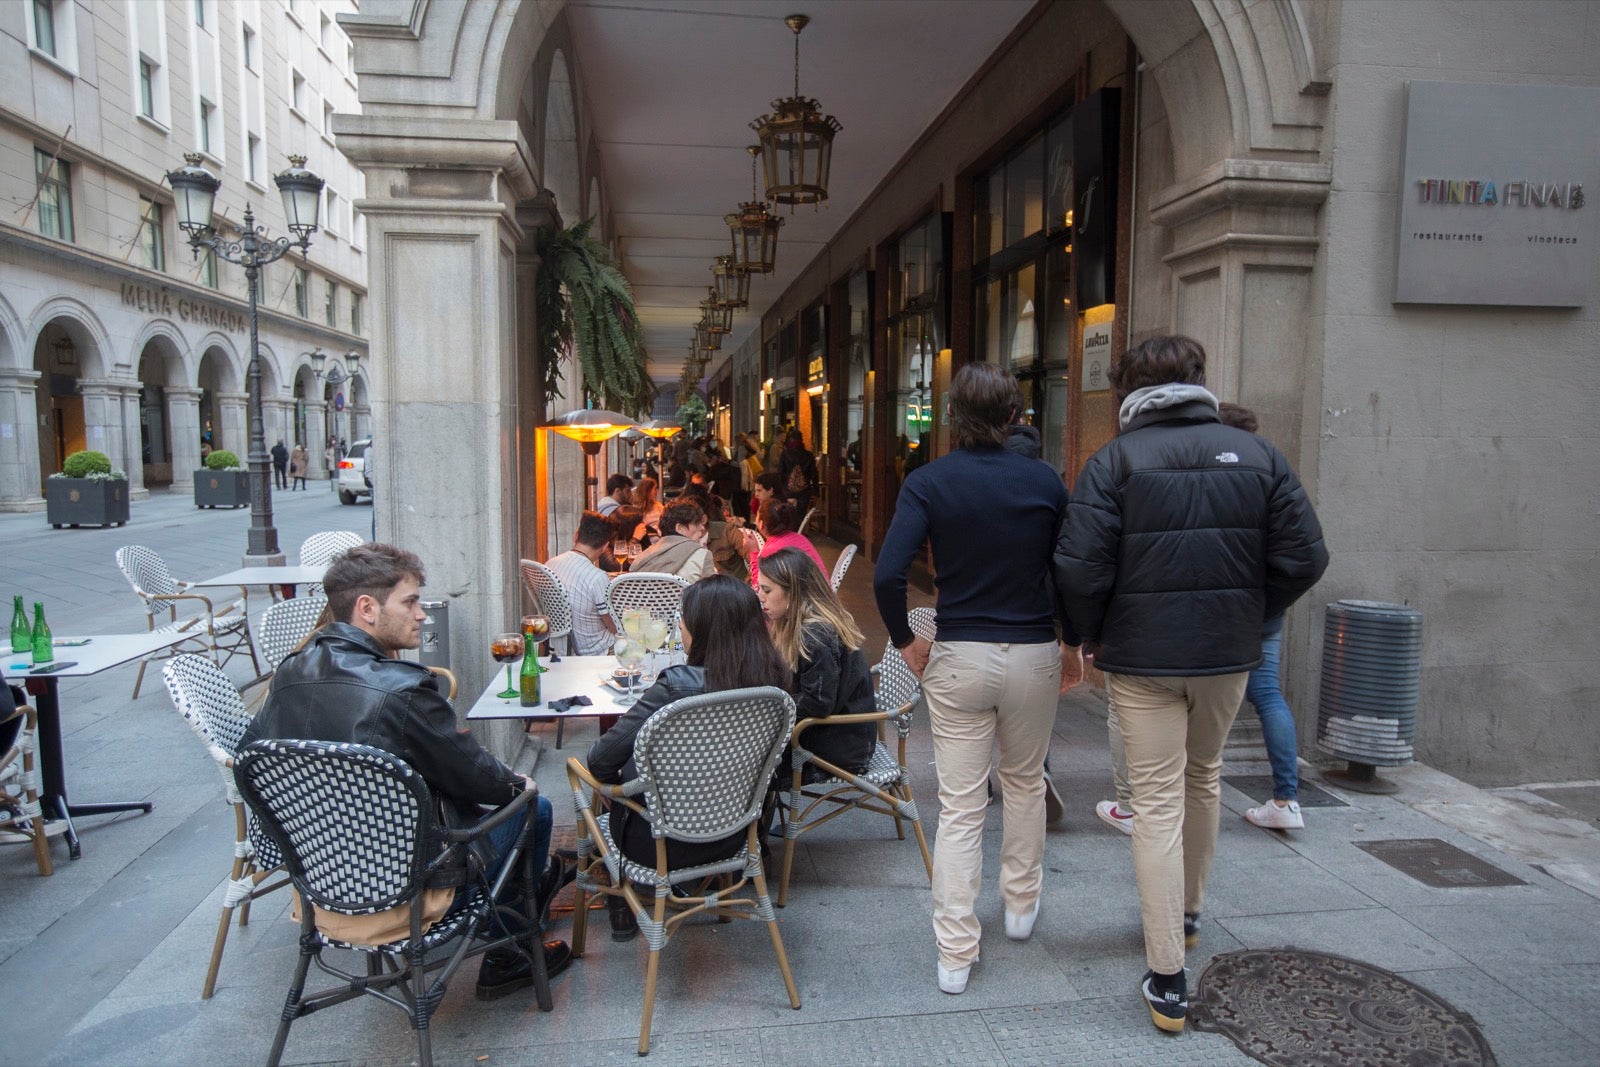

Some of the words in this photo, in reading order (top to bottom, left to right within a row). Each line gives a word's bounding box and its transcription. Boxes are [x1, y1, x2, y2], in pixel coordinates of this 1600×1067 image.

[1418, 178, 1498, 206] TINTA
[1413, 231, 1483, 242] restaurante
[1527, 234, 1577, 245] vinoteca
[178, 298, 246, 335] GRANADA
[1085, 332, 1109, 350] LAVAZZA
[1164, 991, 1180, 1002] NIKE
